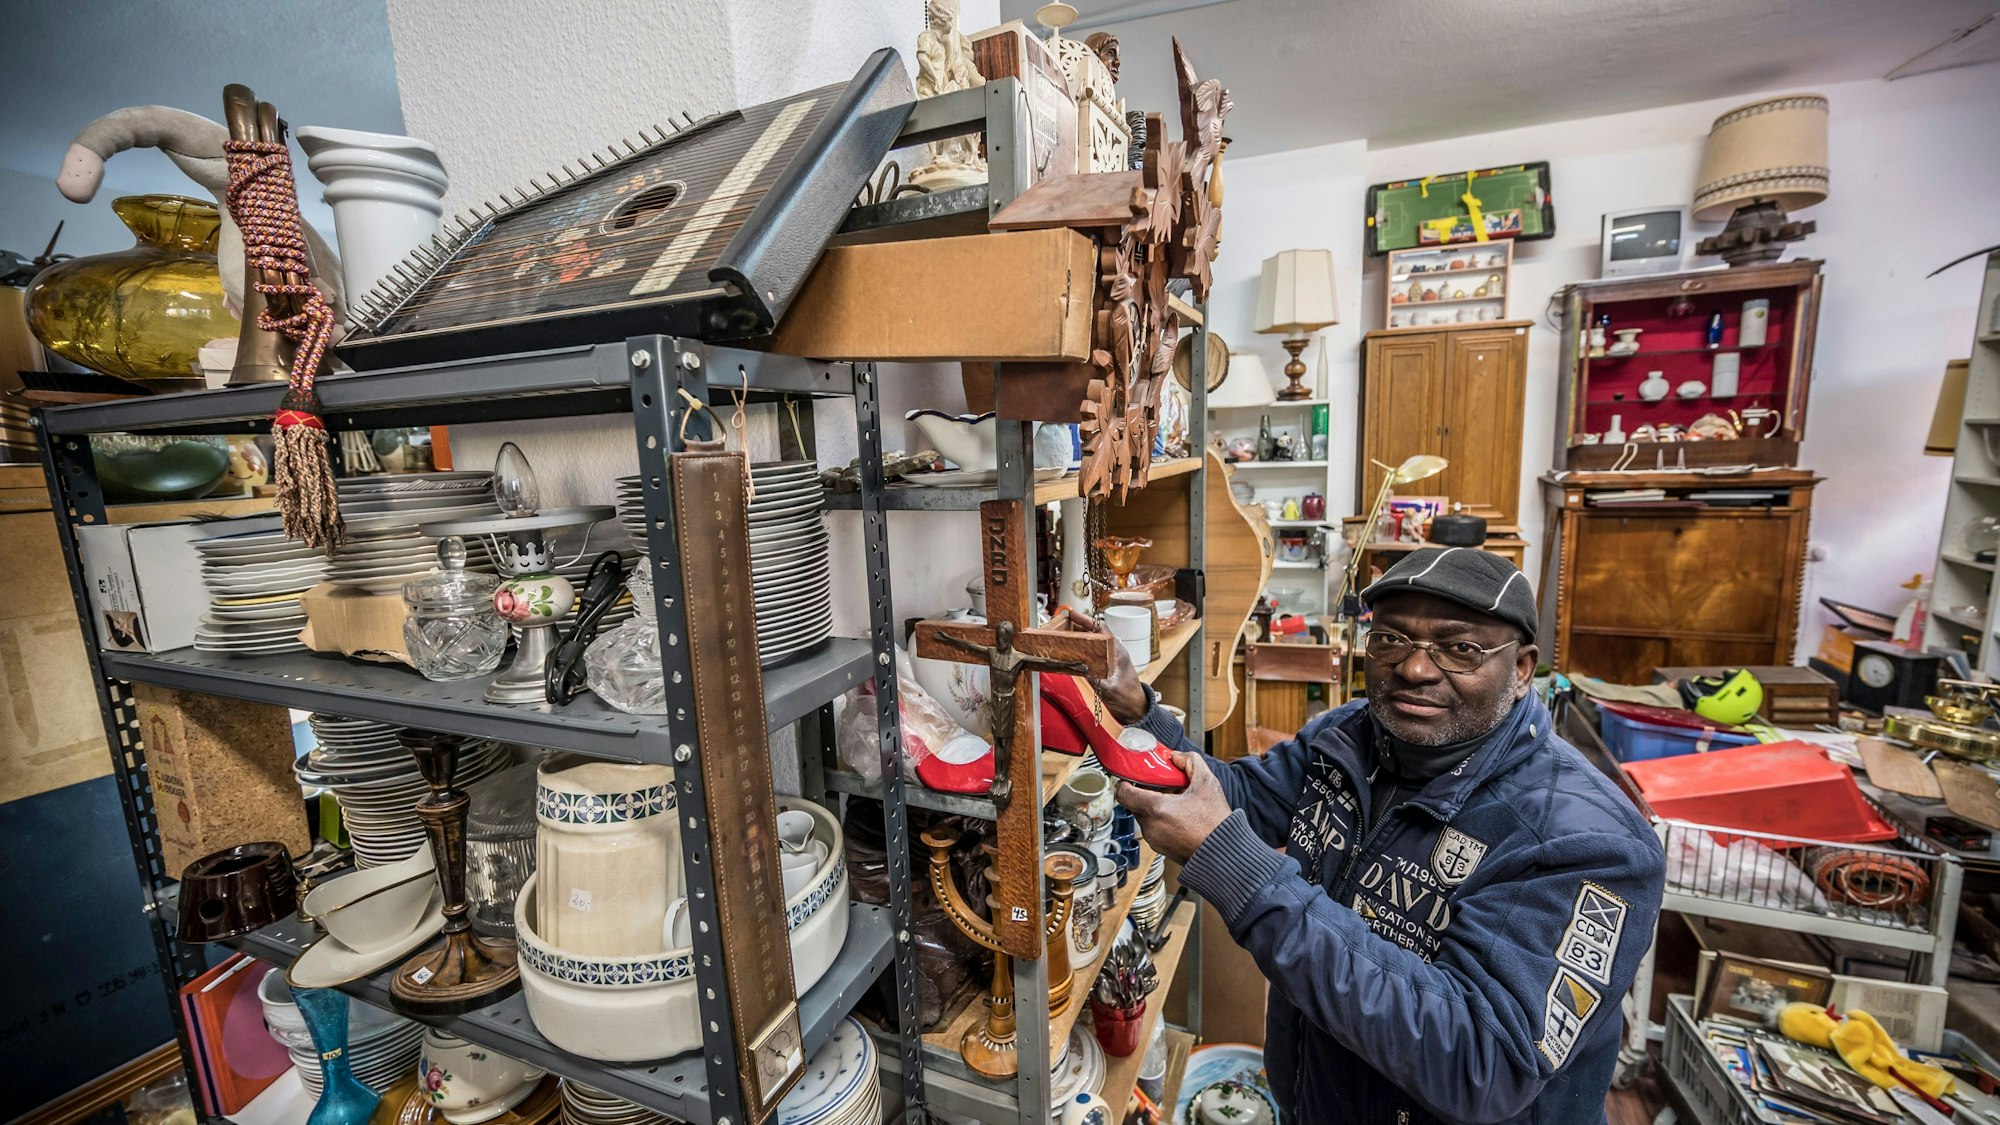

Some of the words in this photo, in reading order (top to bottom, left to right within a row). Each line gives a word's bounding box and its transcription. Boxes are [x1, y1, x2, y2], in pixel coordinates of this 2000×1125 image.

[713, 491, 720, 502] 2
[715, 510, 722, 520] 3
[718, 529, 725, 540] 4
[720, 548, 727, 558] 5
[722, 566, 728, 576] 6
[723, 584, 730, 594] 7
[1571, 941, 1602, 971] 63
